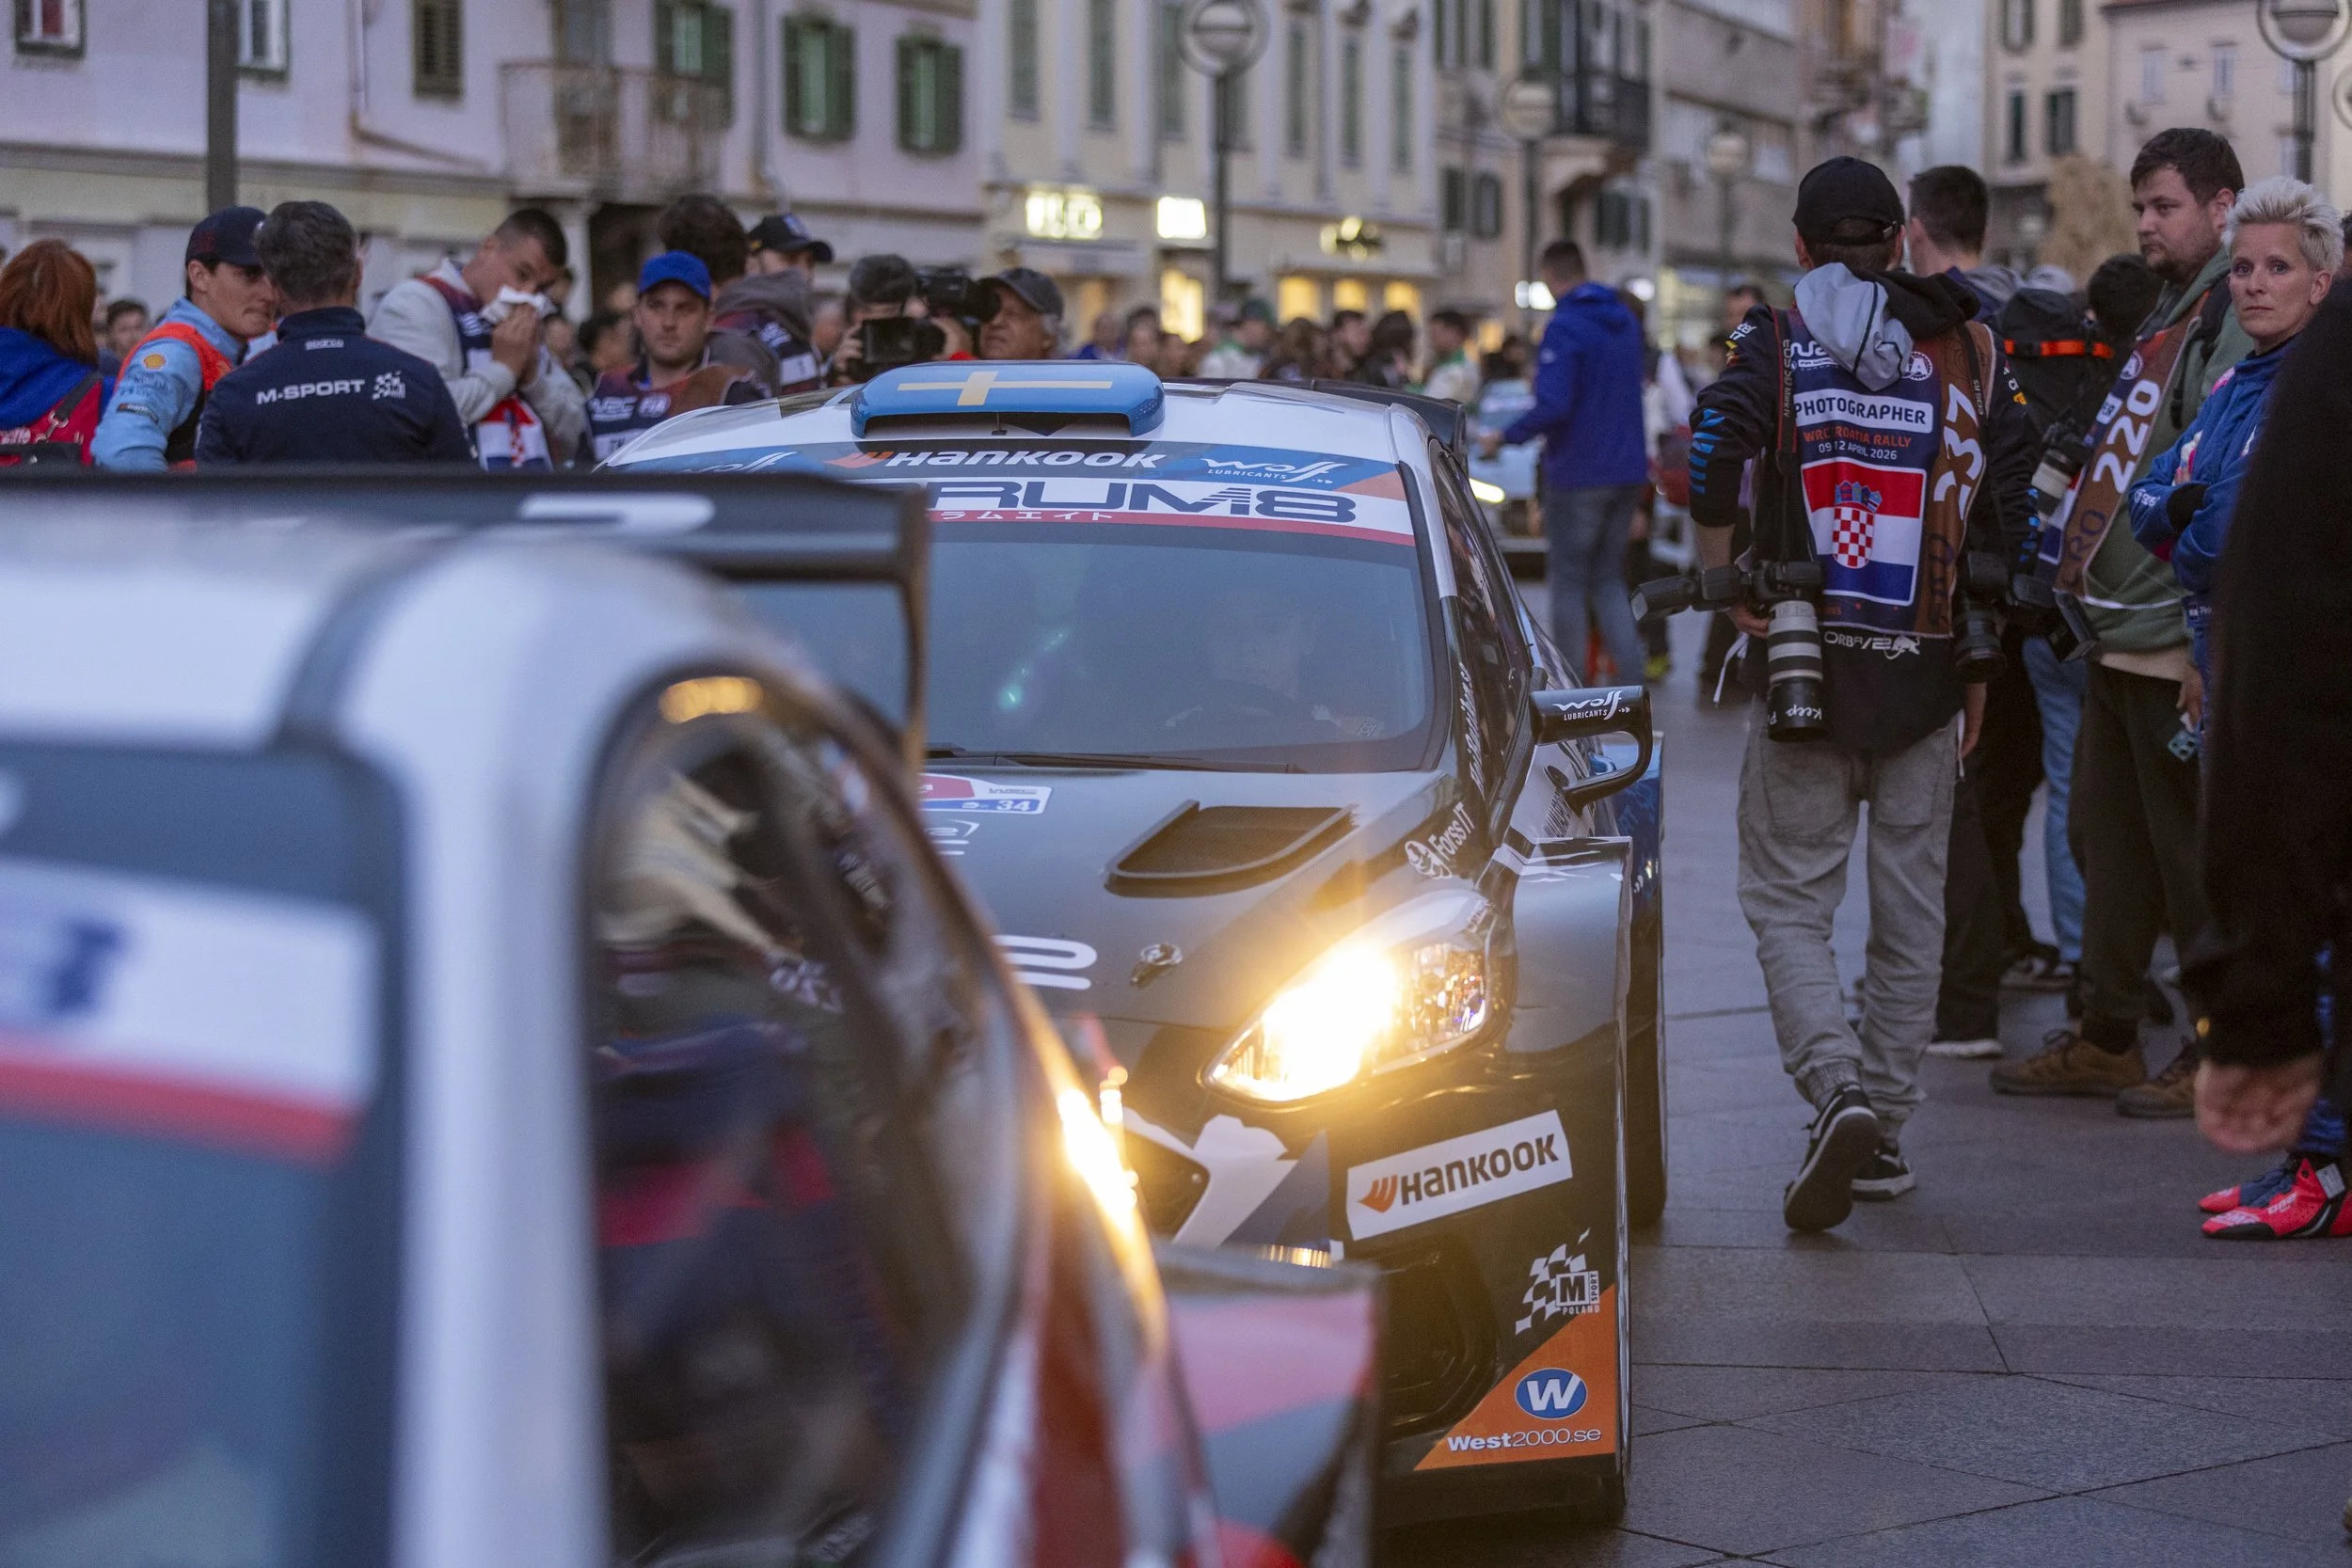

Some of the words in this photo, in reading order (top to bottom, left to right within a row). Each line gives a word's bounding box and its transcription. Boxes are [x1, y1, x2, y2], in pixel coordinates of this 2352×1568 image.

[257, 378, 366, 404] M-SPORT
[1795, 397, 1926, 424] PHOTOGRAPHER
[1835, 426, 1870, 443] ROATIA
[1873, 436, 1913, 448] RALLY
[2092, 379, 2162, 494] 220
[1870, 449, 1898, 460] 2026
[1208, 468, 1288, 481] LUBRICANTS
[851, 481, 1357, 523] RUM8
[941, 511, 1113, 521] ラムエイト
[1564, 709, 1608, 721] LUBRICANTS
[996, 800, 1031, 812] 34
[1560, 1275, 1586, 1303] M
[1563, 1304, 1600, 1316] POLAND
[1526, 1373, 1582, 1411] W
[1447, 1428, 1602, 1452] West2000.se
